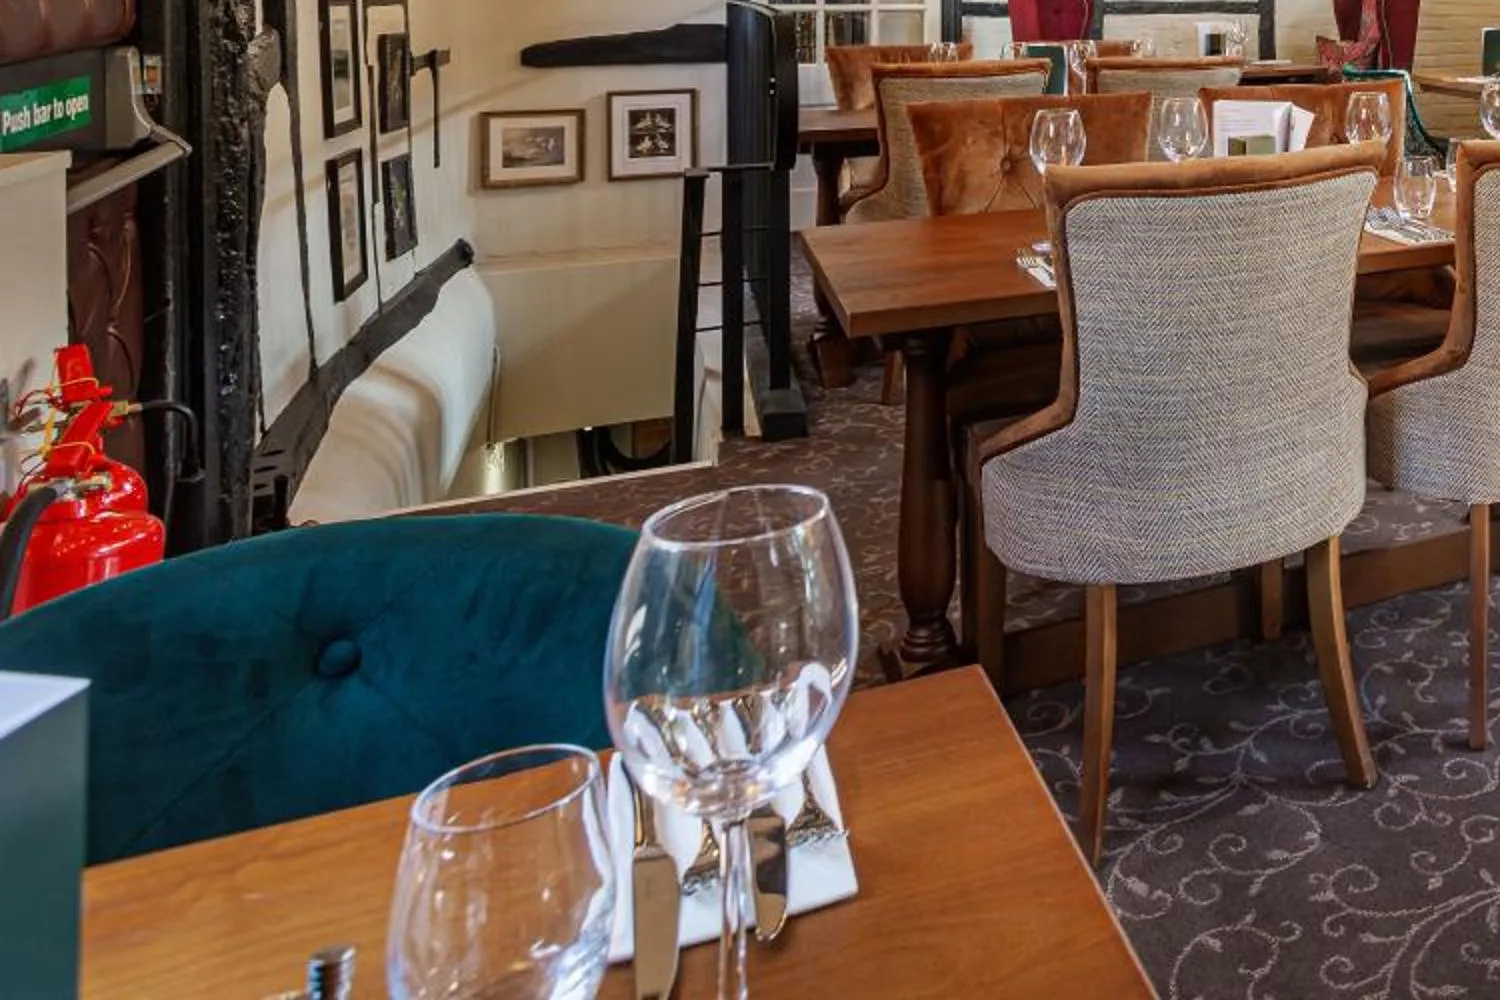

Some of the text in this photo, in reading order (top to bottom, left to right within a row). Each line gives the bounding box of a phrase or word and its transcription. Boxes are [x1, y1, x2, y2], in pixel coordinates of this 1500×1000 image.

[2, 93, 89, 136] Push bar to open
